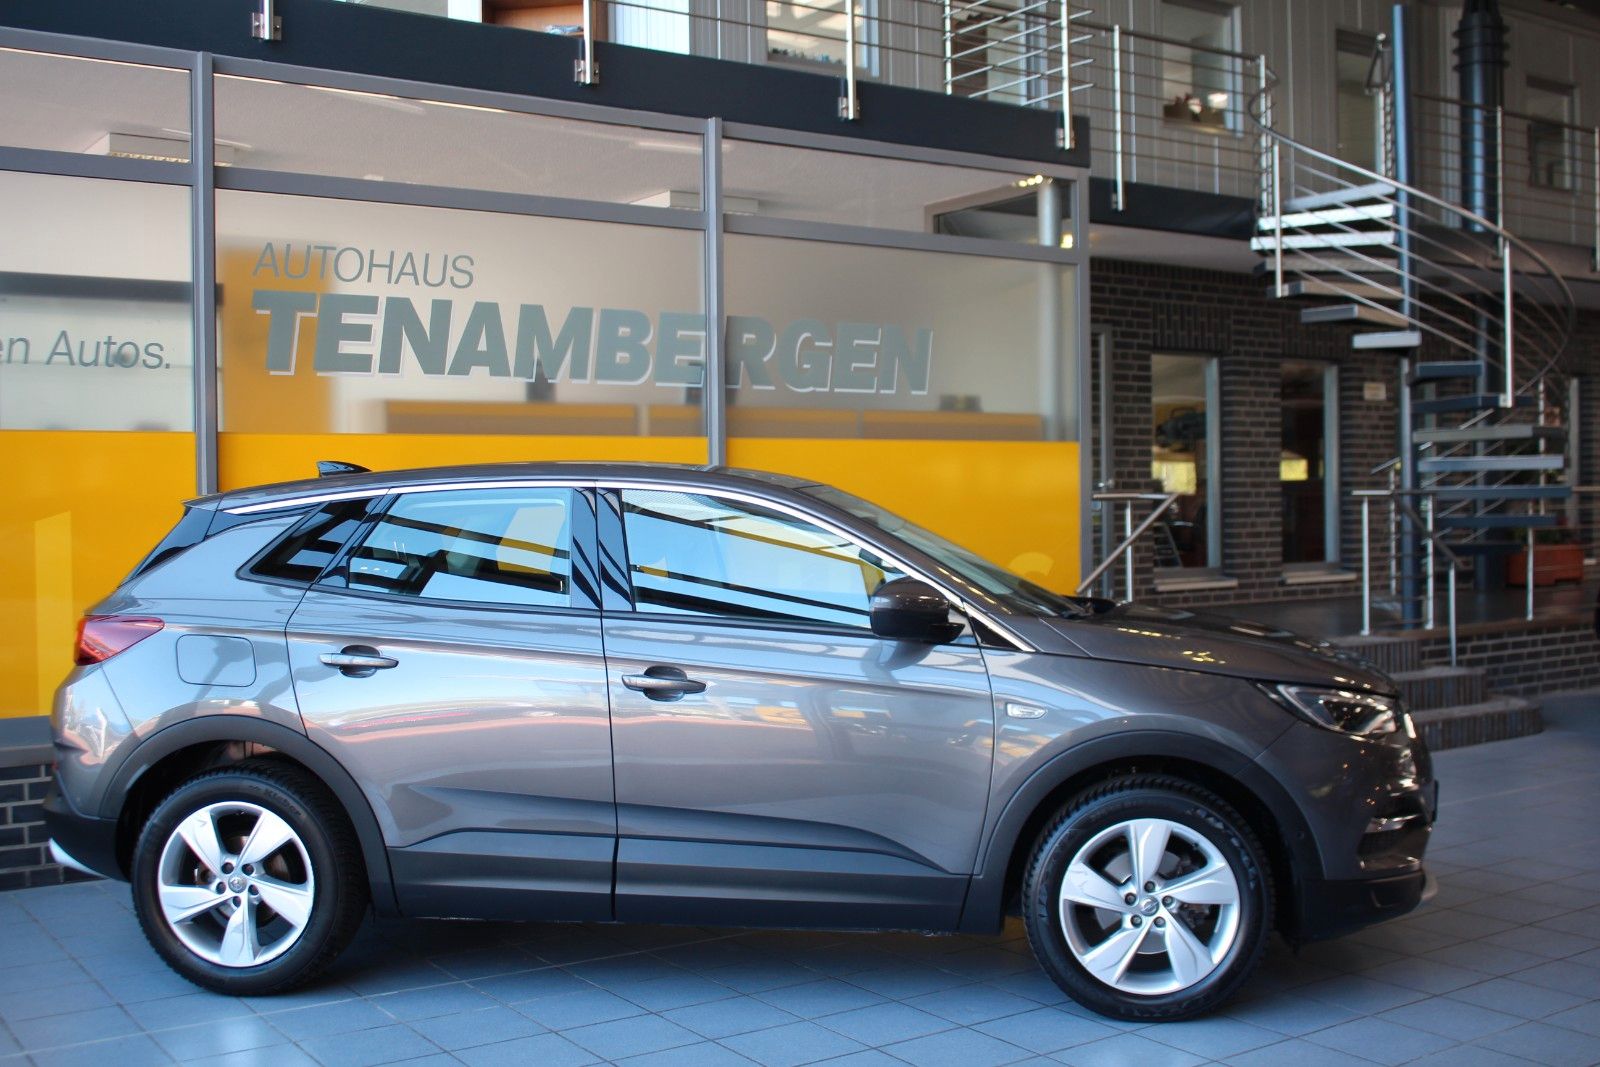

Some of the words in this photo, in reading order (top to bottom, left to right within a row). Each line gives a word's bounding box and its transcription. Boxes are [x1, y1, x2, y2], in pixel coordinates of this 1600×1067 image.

[252, 241, 475, 289] AUTOHAUS
[45, 329, 171, 370] Autos.
[251, 289, 933, 397] TENAMBERGEN
